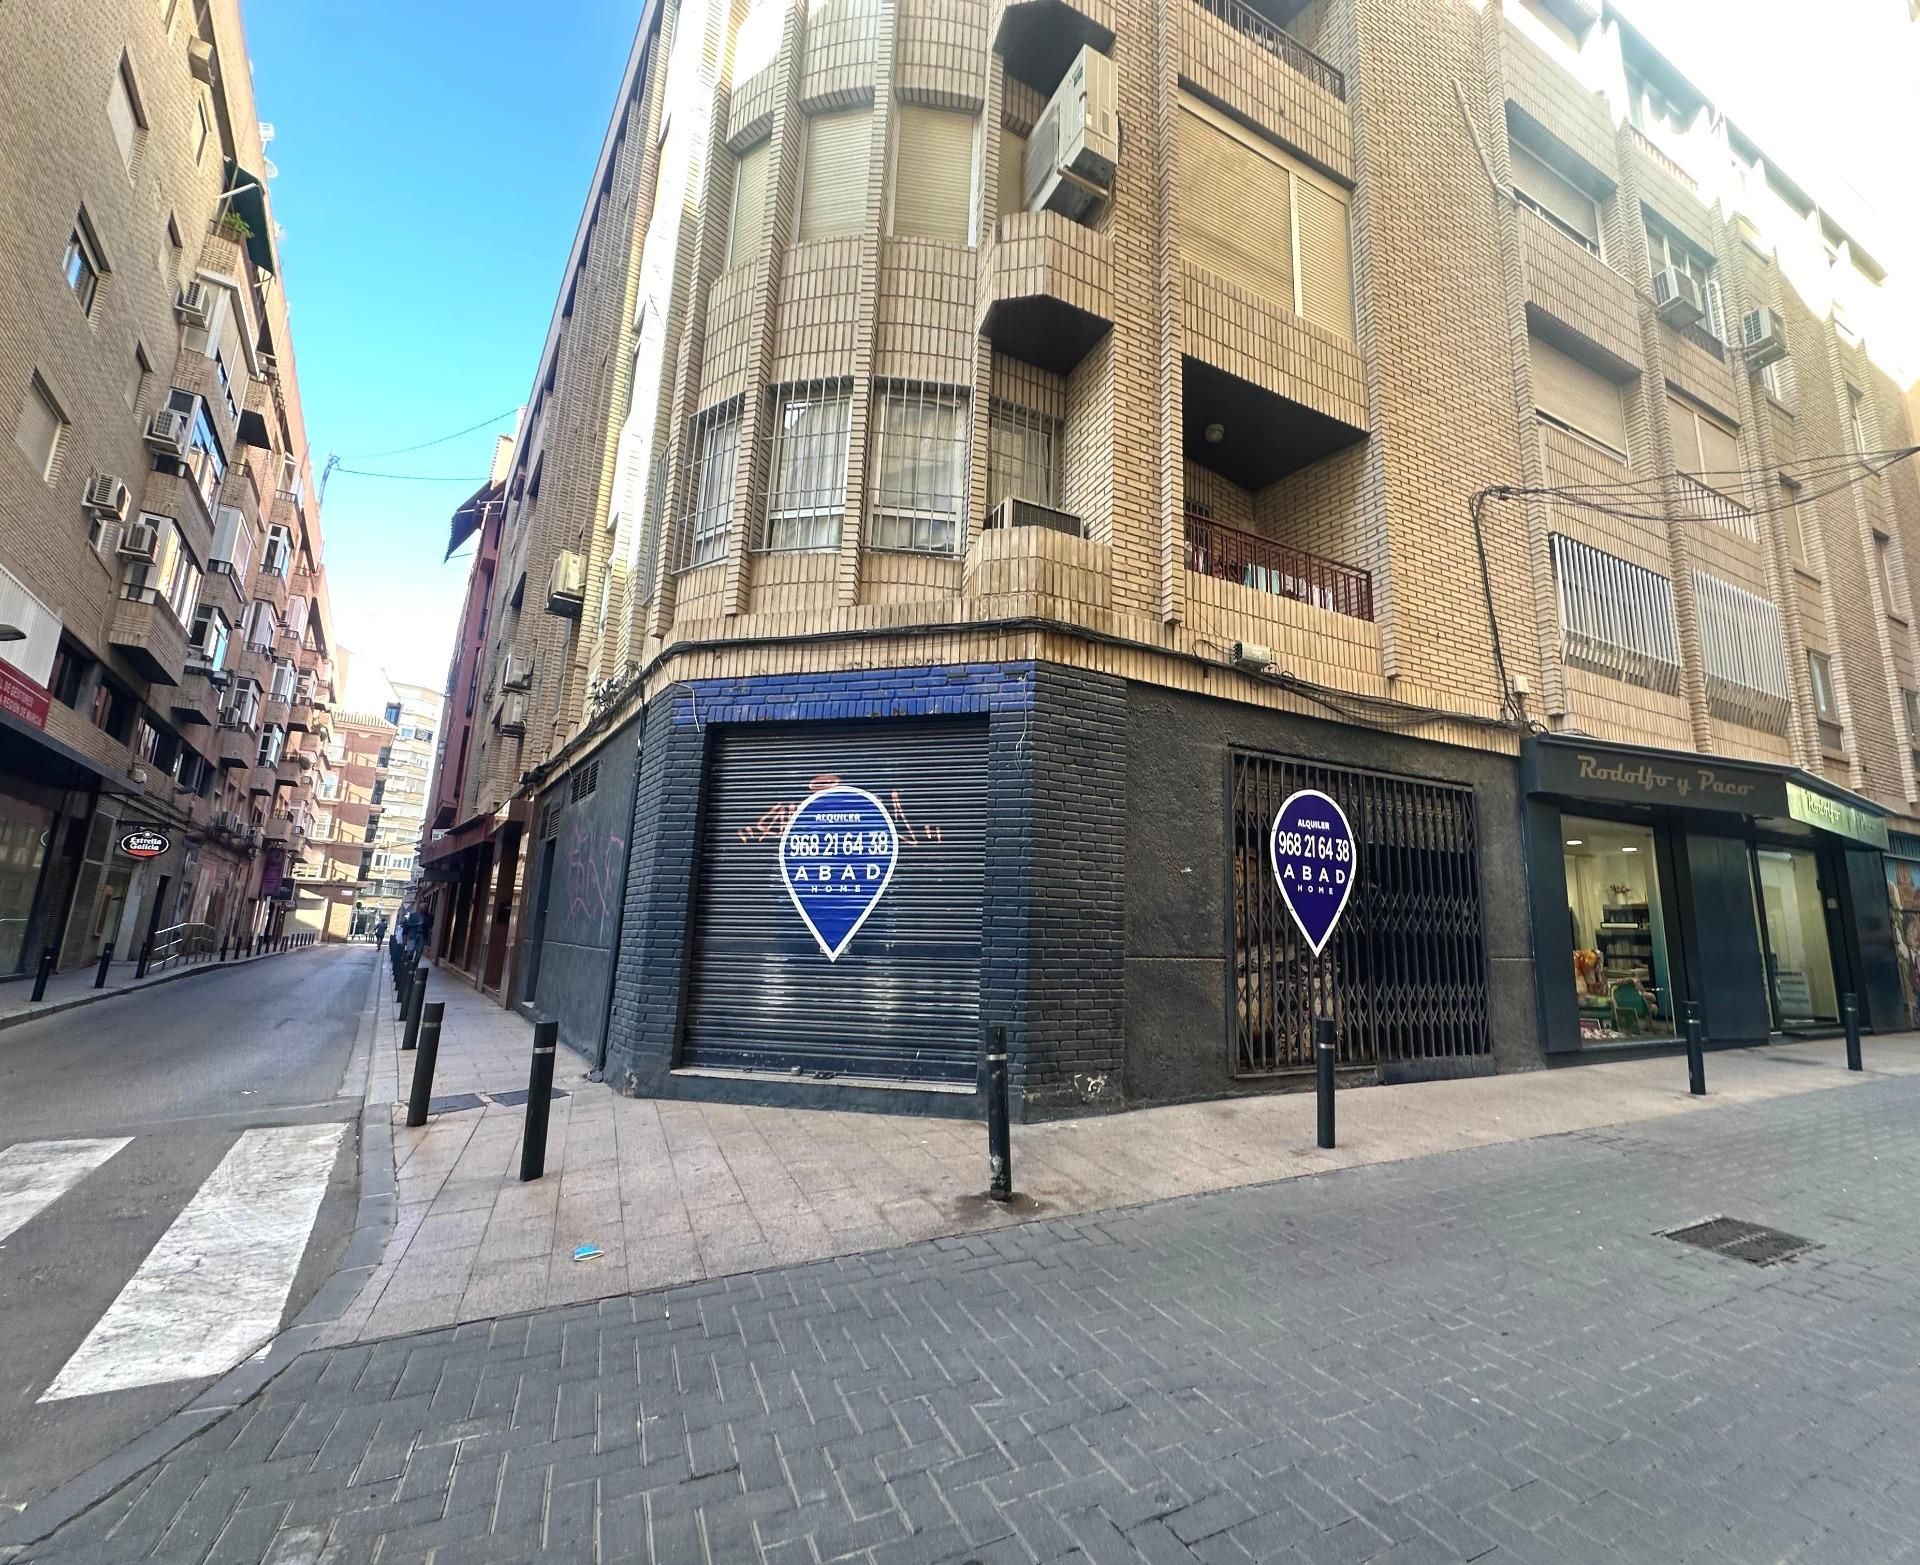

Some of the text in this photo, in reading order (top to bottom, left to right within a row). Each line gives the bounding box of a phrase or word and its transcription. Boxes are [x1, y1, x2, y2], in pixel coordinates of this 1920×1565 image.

[1577, 755, 1756, 797] Rodolfo y Paco
[815, 813, 861, 823] ALQUILER
[1297, 819, 1330, 830] ALQUILER
[129, 836, 162, 845] Estrella
[789, 831, 889, 857] 968 21 64 38
[1278, 830, 1350, 862] 968 21 64 38
[130, 843, 159, 851] Galicia
[793, 864, 881, 881] ABAD
[1283, 863, 1346, 884] ABAD
[811, 884, 861, 893] HOME
[1297, 884, 1334, 895] HOME
